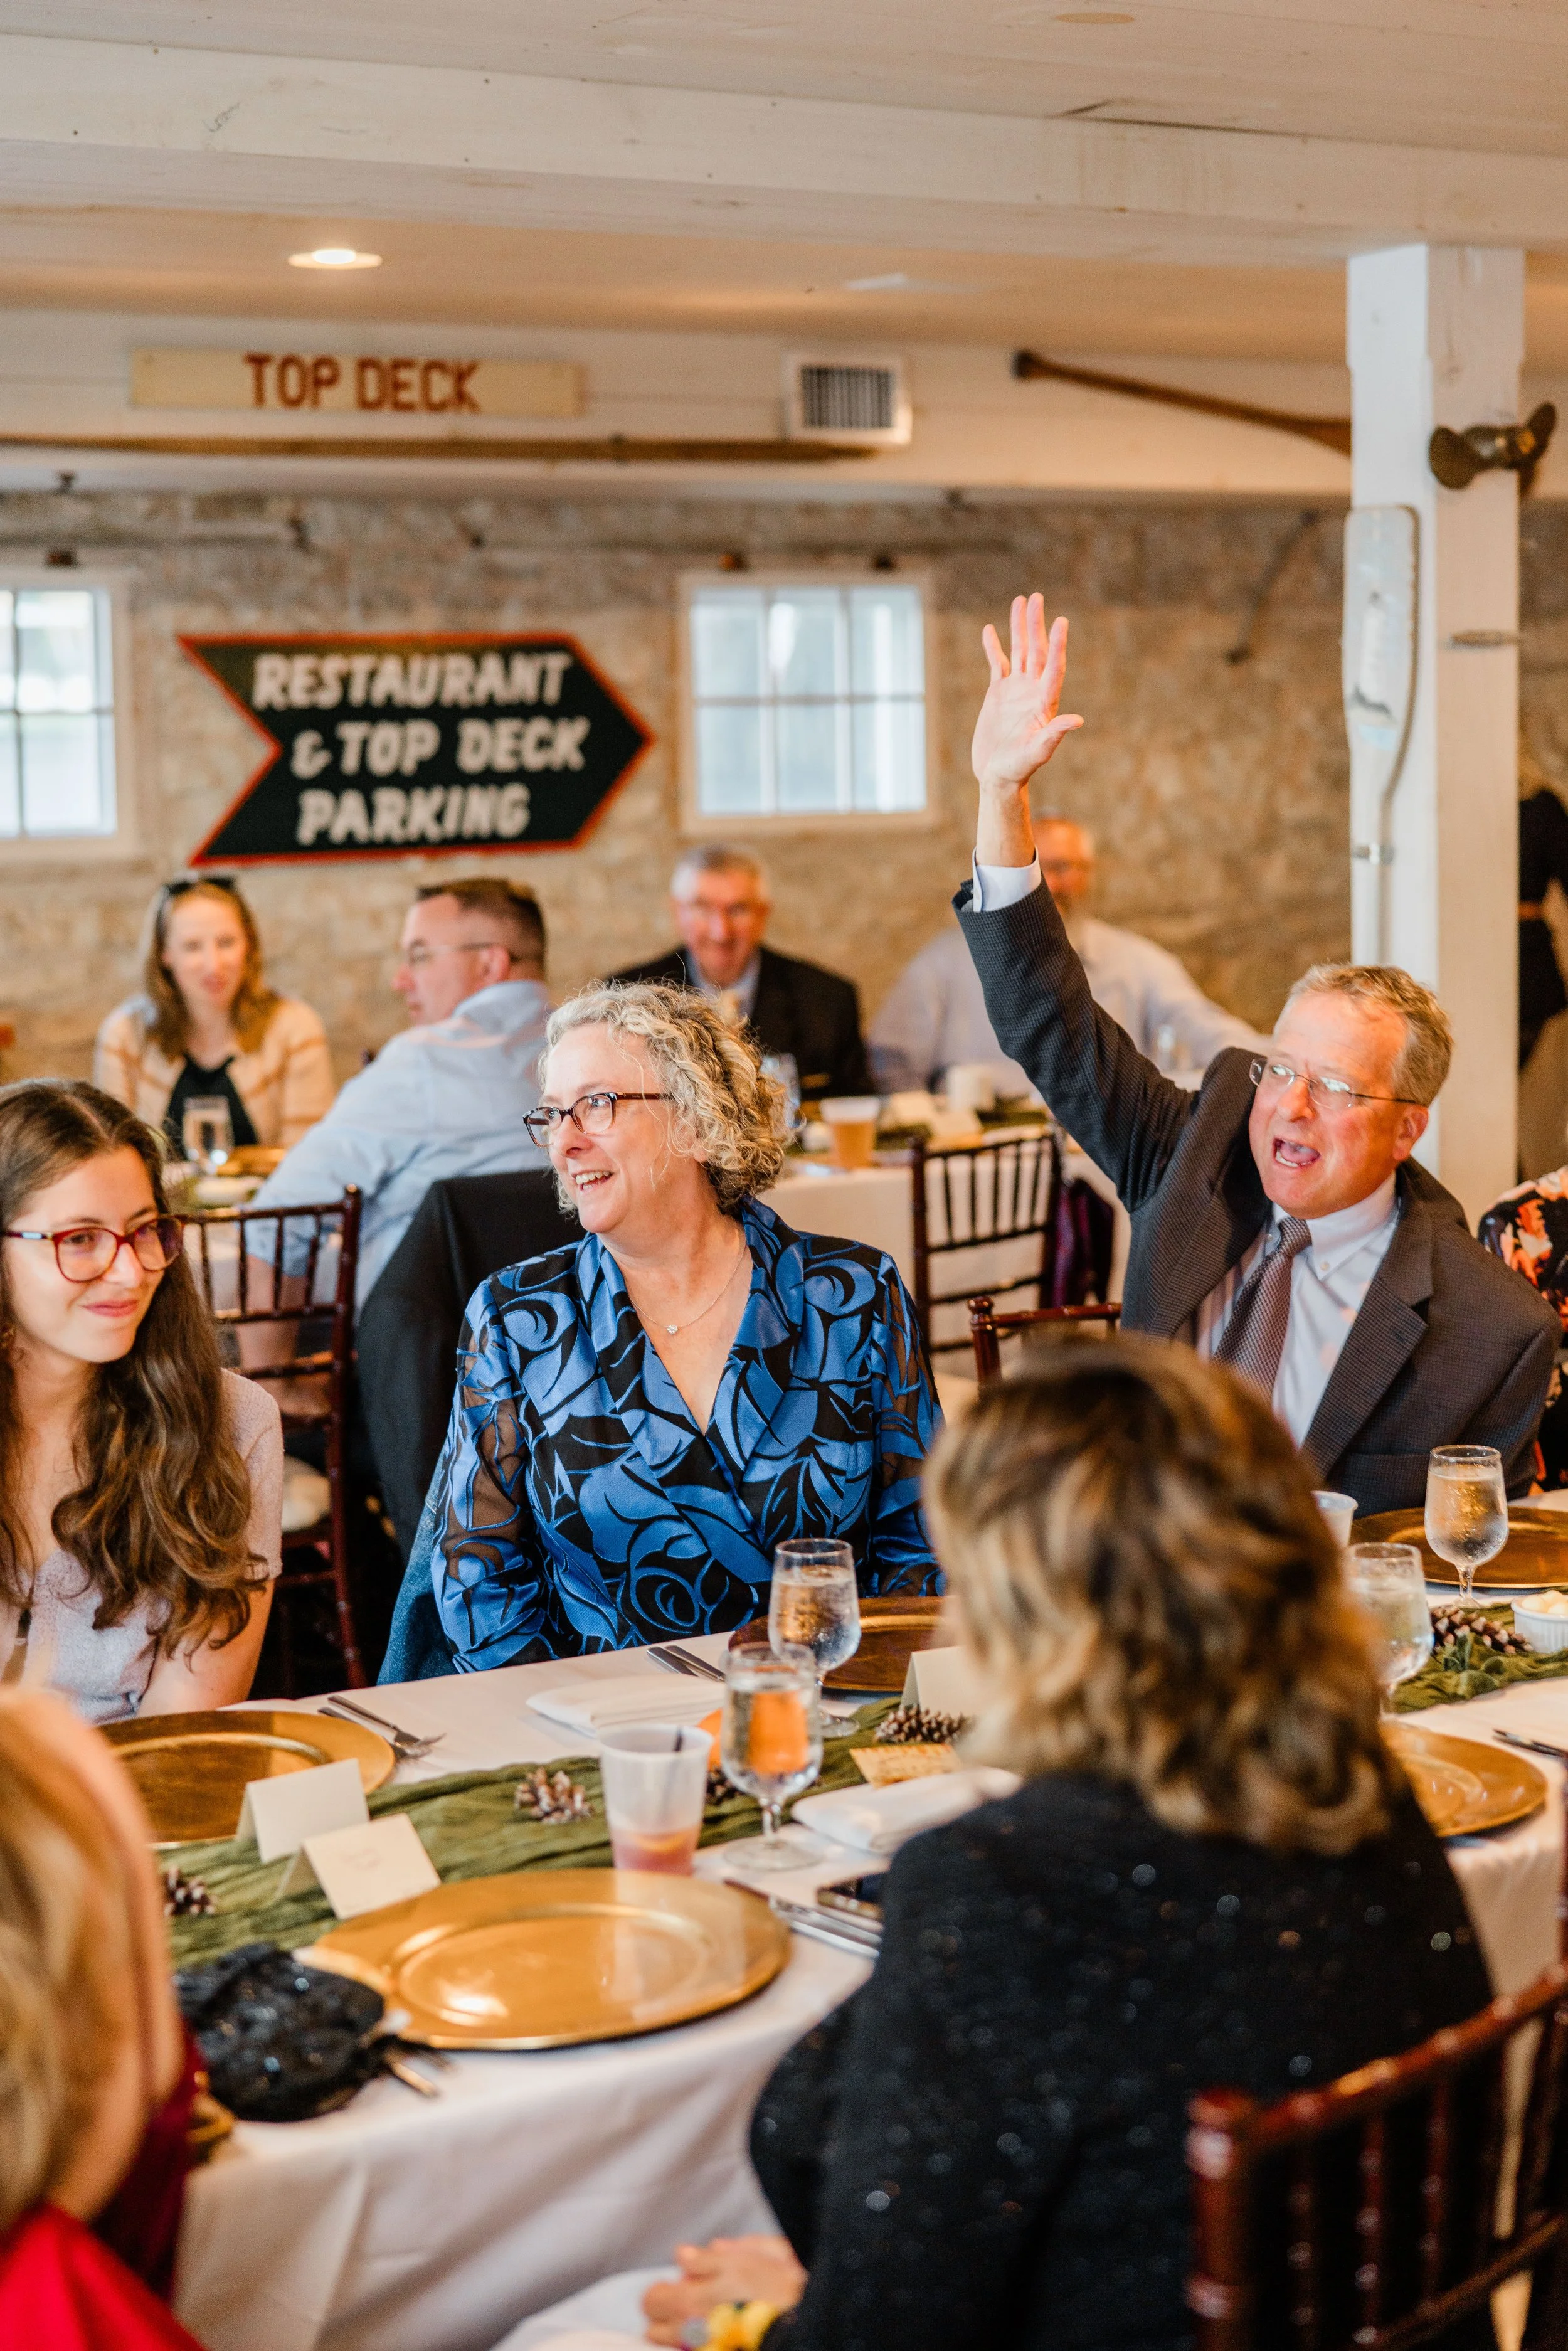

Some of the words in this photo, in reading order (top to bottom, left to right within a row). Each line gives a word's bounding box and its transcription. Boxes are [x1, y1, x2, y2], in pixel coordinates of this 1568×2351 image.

[243, 353, 341, 408] TOP
[355, 358, 482, 412] DECK
[253, 654, 571, 710] RESTAURANT
[292, 730, 331, 778] &
[336, 719, 439, 777] TOP
[458, 716, 590, 773] DECK
[297, 783, 531, 845] PARKING
